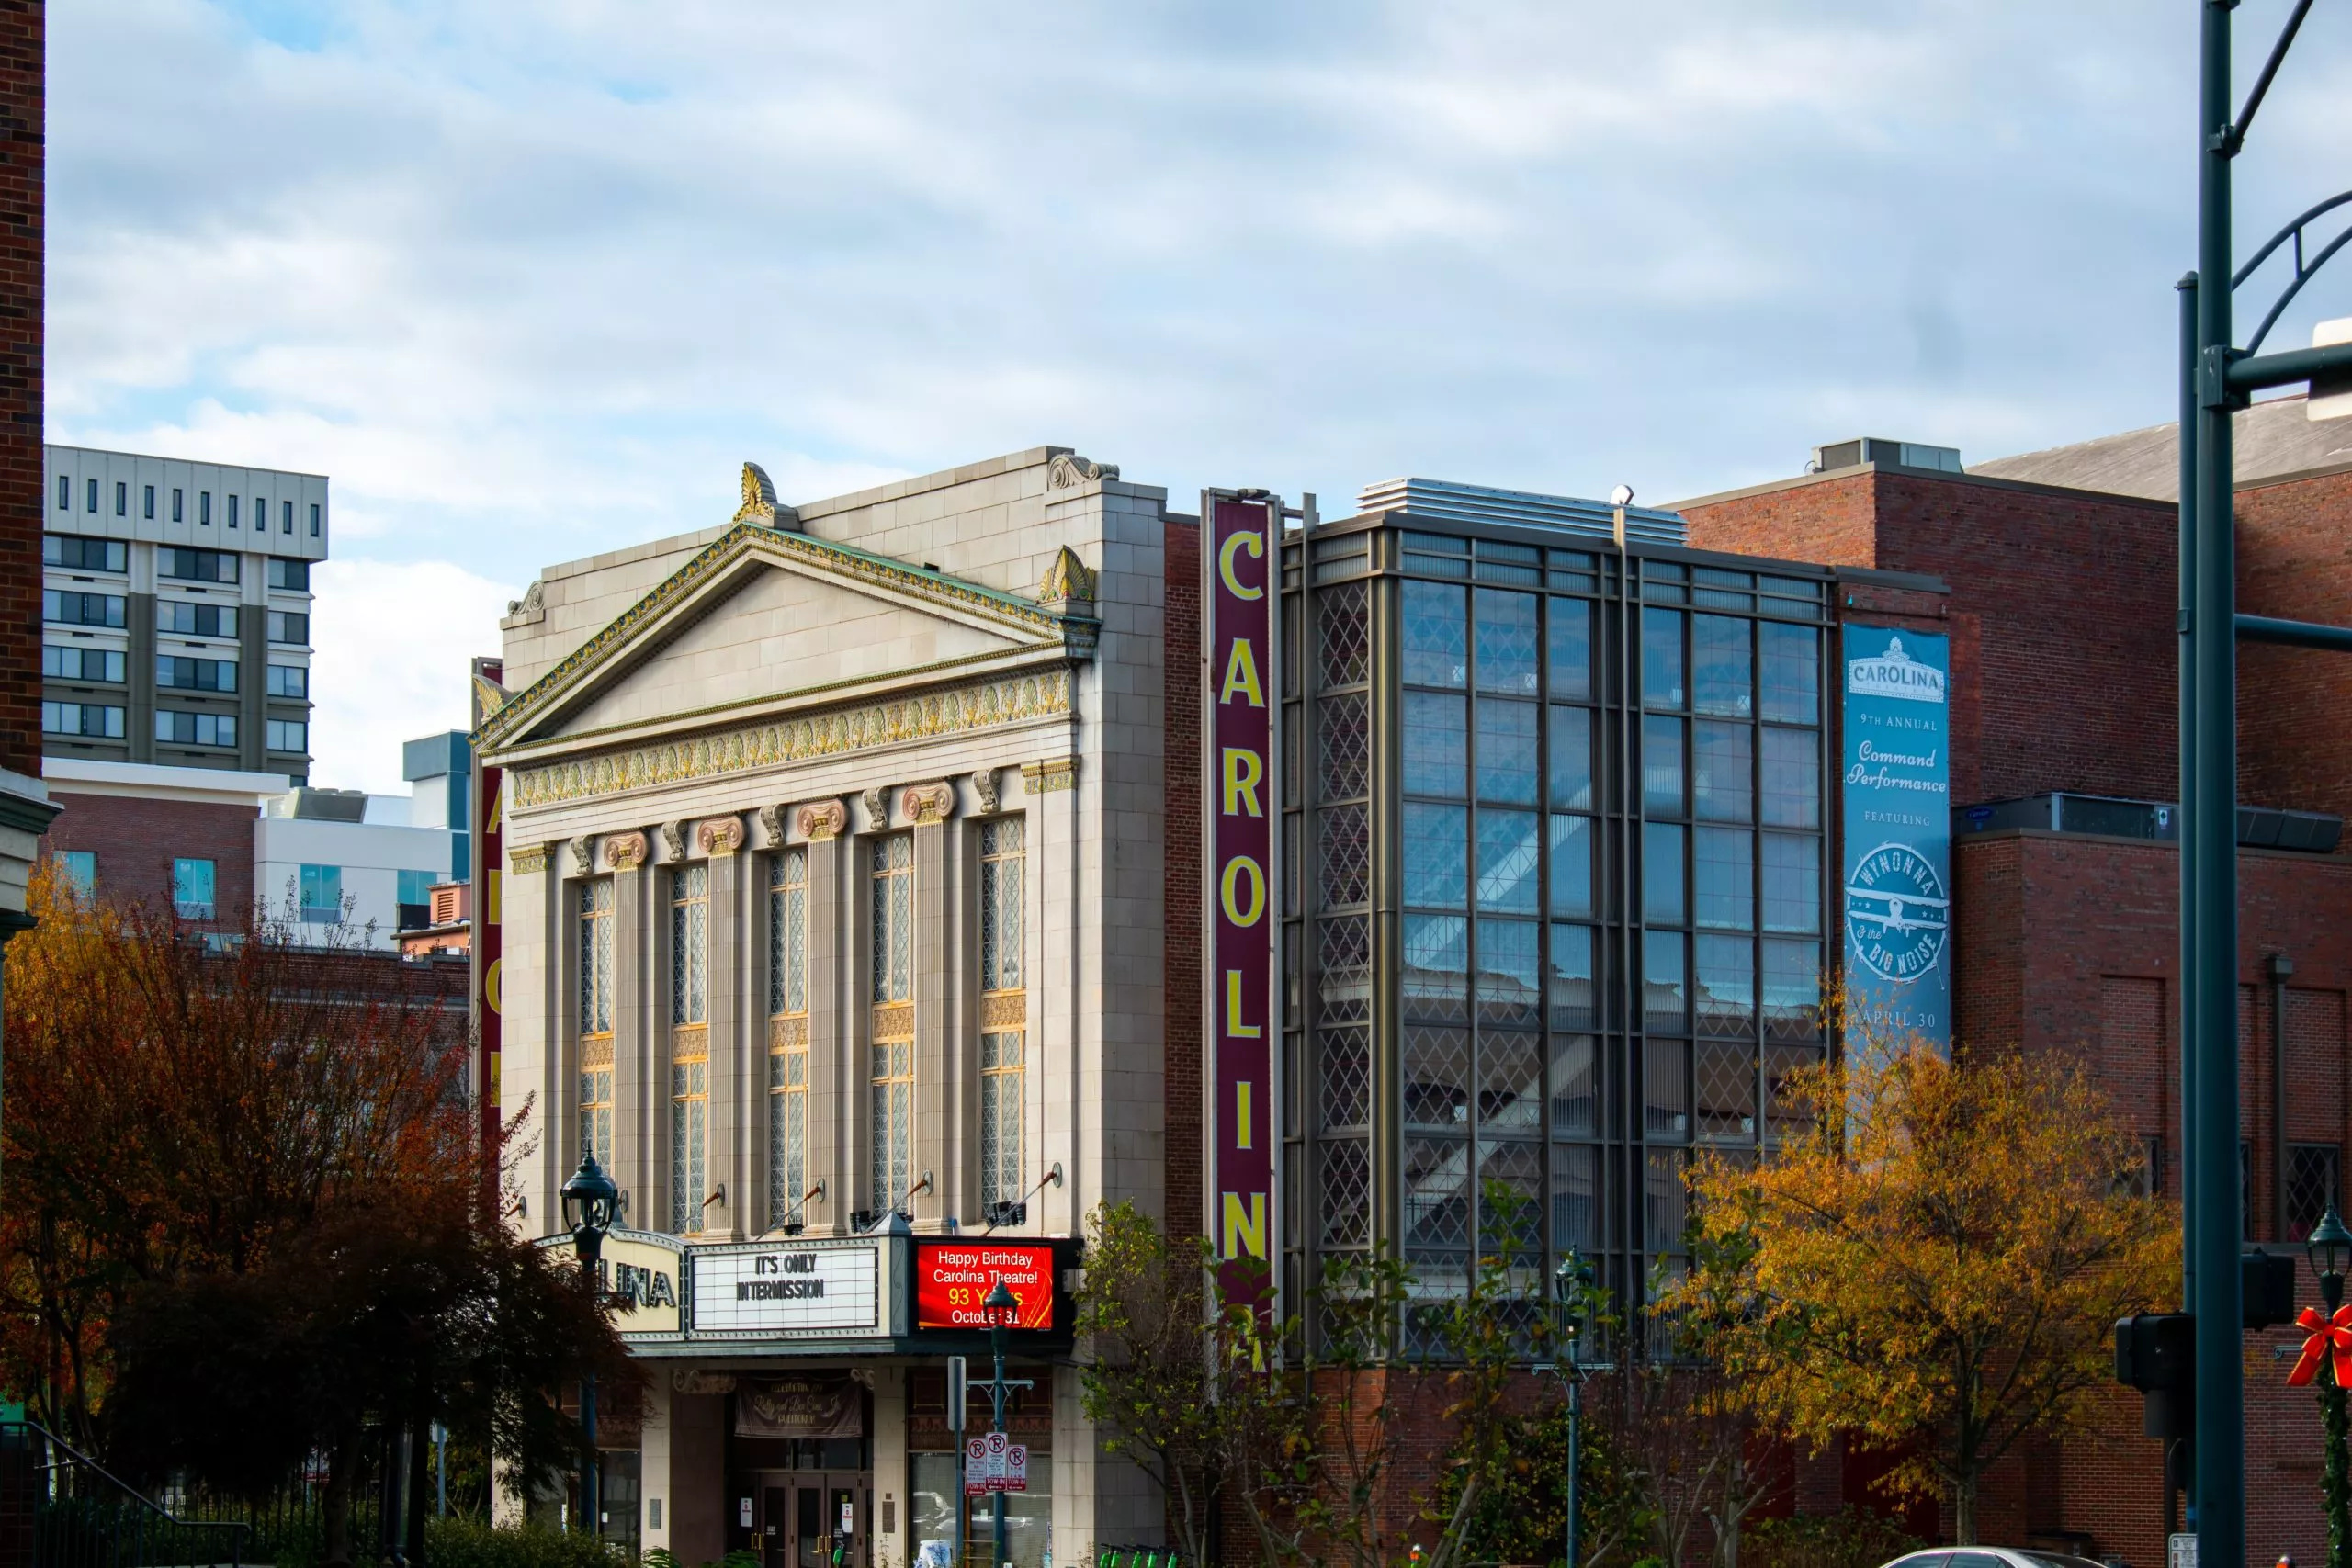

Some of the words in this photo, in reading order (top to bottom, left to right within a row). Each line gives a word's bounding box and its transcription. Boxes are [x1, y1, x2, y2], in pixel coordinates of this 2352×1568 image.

[1854, 666, 1939, 690] CAROLINA
[1860, 713, 1881, 726] 9TH
[1886, 716, 1937, 731] ANNUAL
[1859, 740, 1936, 768] Command
[1847, 763, 1946, 793] Performance
[1864, 811, 1930, 827] FEATURING
[1859, 851, 1935, 896] WYNONNA
[1857, 925, 1866, 939] &
[1868, 927, 1882, 940] the
[1869, 943, 1894, 972] BIG
[1896, 933, 1937, 975] NOISE
[1863, 1010, 1911, 1027] APRIL
[1918, 1013, 1936, 1028] 30
[755, 1255, 778, 1275] IT'S
[784, 1253, 817, 1274] ONLY
[938, 1251, 978, 1268] Happy
[982, 1252, 1033, 1269] Birthday
[933, 1269, 985, 1283] Carolina
[989, 1269, 1038, 1284] Theatre!
[737, 1279, 824, 1301] INTERMISSION
[948, 1288, 969, 1305] 93
[1005, 1310, 1020, 1324] 31
